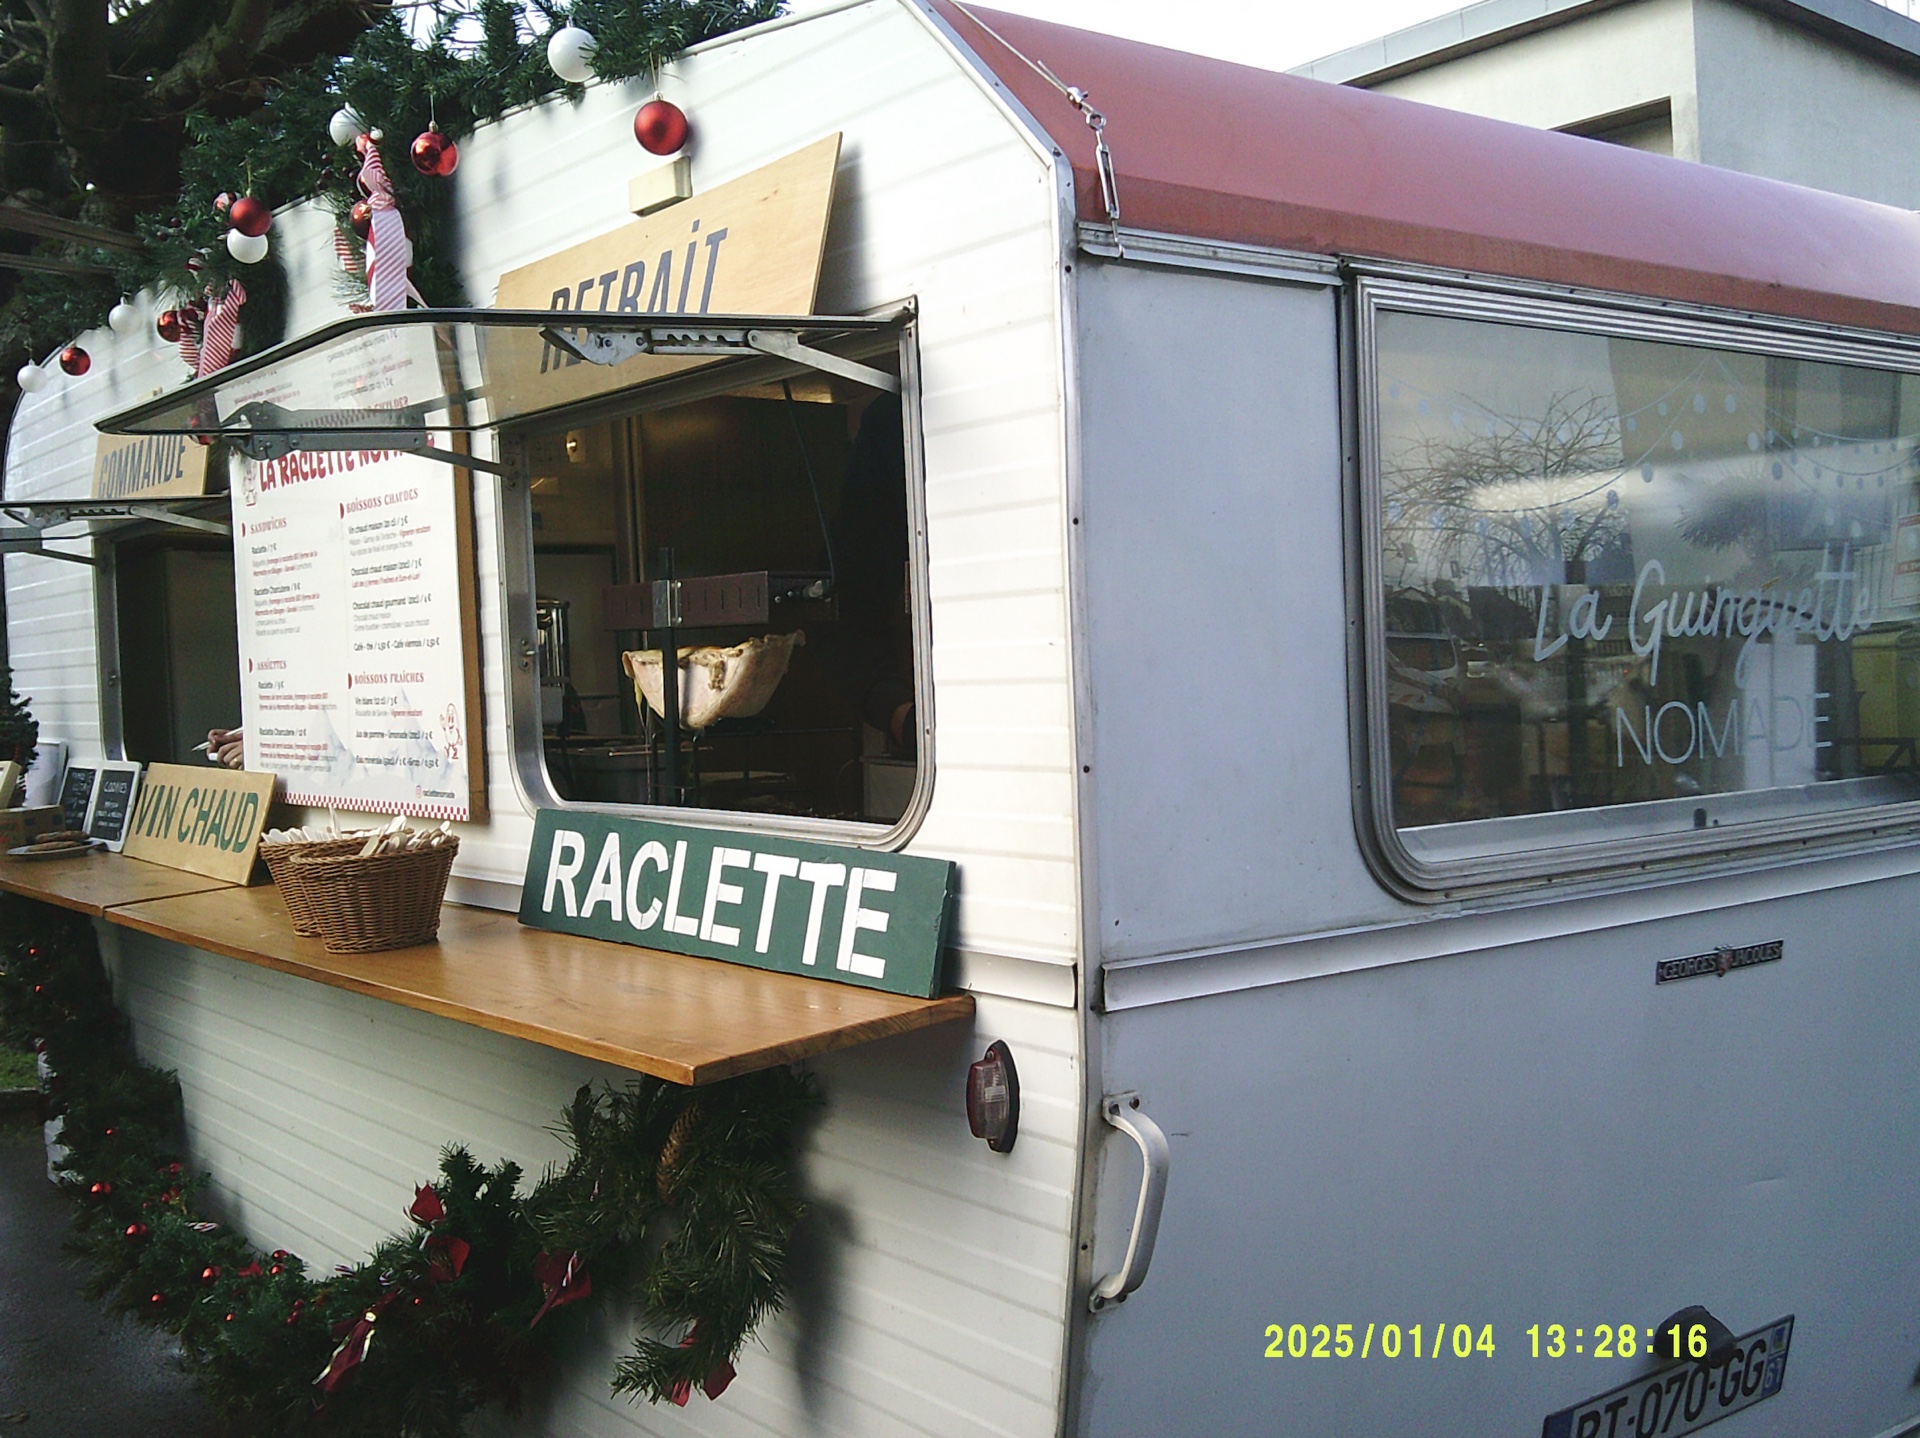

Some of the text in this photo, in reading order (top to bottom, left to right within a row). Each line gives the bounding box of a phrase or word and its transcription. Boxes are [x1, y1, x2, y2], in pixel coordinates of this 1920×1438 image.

[98, 435, 186, 498] COMMANDE
[260, 451, 354, 492] LA RACLETTE
[1534, 541, 1877, 689] La Guinguette
[1616, 692, 1832, 768] NOMADE
[135, 784, 259, 853] VIN CHAUD
[542, 829, 898, 979] RACLETTE
[1663, 954, 1716, 979] GEORGES
